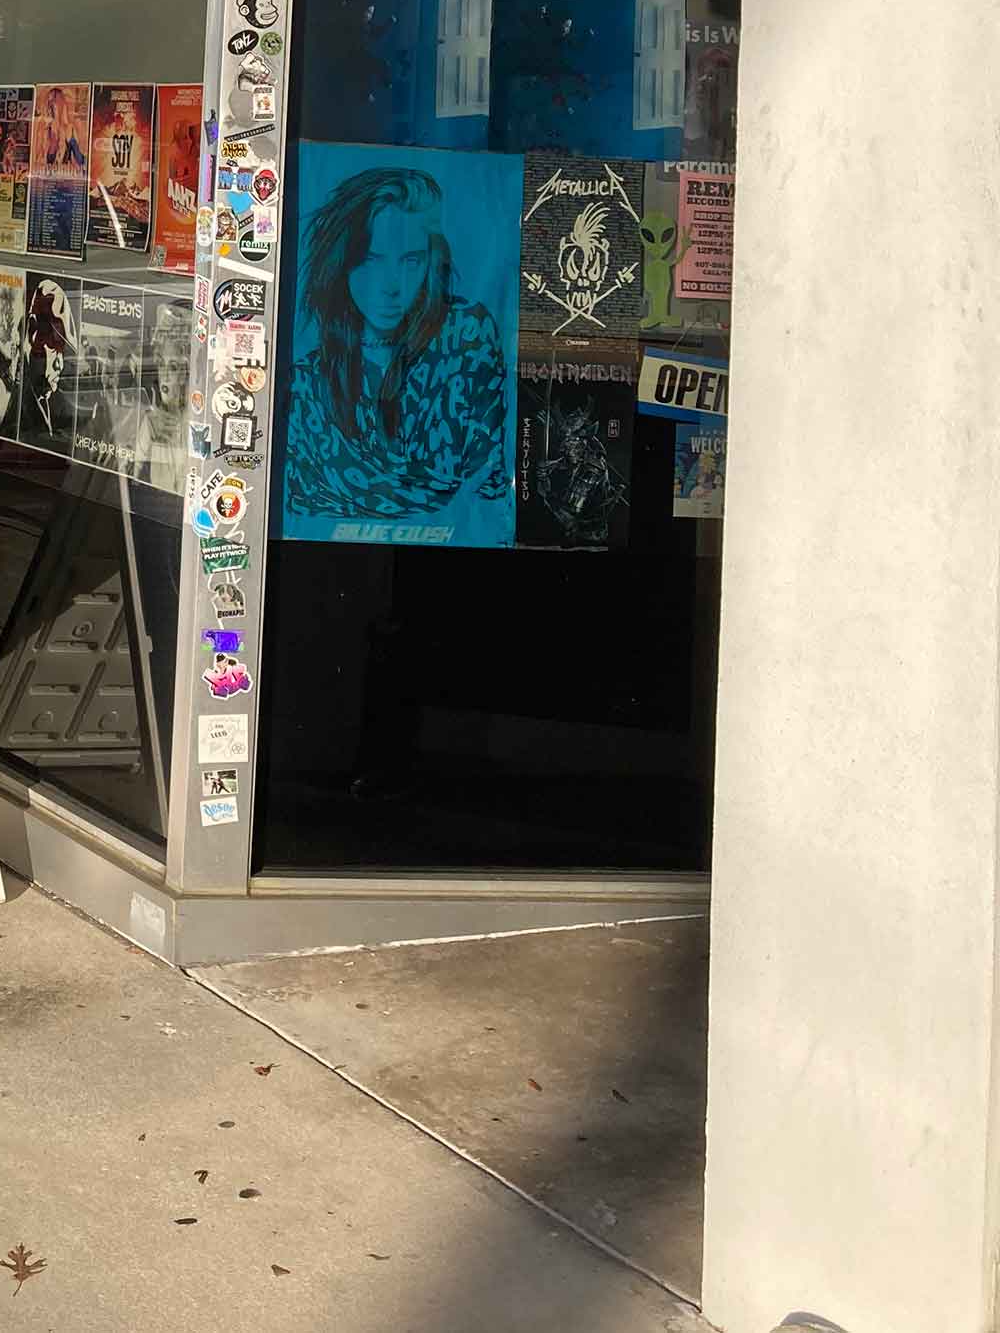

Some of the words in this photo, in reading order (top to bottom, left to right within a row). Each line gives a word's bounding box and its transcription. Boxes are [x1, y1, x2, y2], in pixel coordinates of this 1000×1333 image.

[524, 163, 640, 222] METALLICA
[233, 282, 264, 294] SOCEK
[83, 294, 117, 314] BEASTIE
[118, 298, 143, 318] BOYS
[689, 436, 727, 454] WELC
[201, 471, 223, 499] CAFE
[330, 523, 392, 541] BILLIE
[392, 525, 455, 543] EILISH
